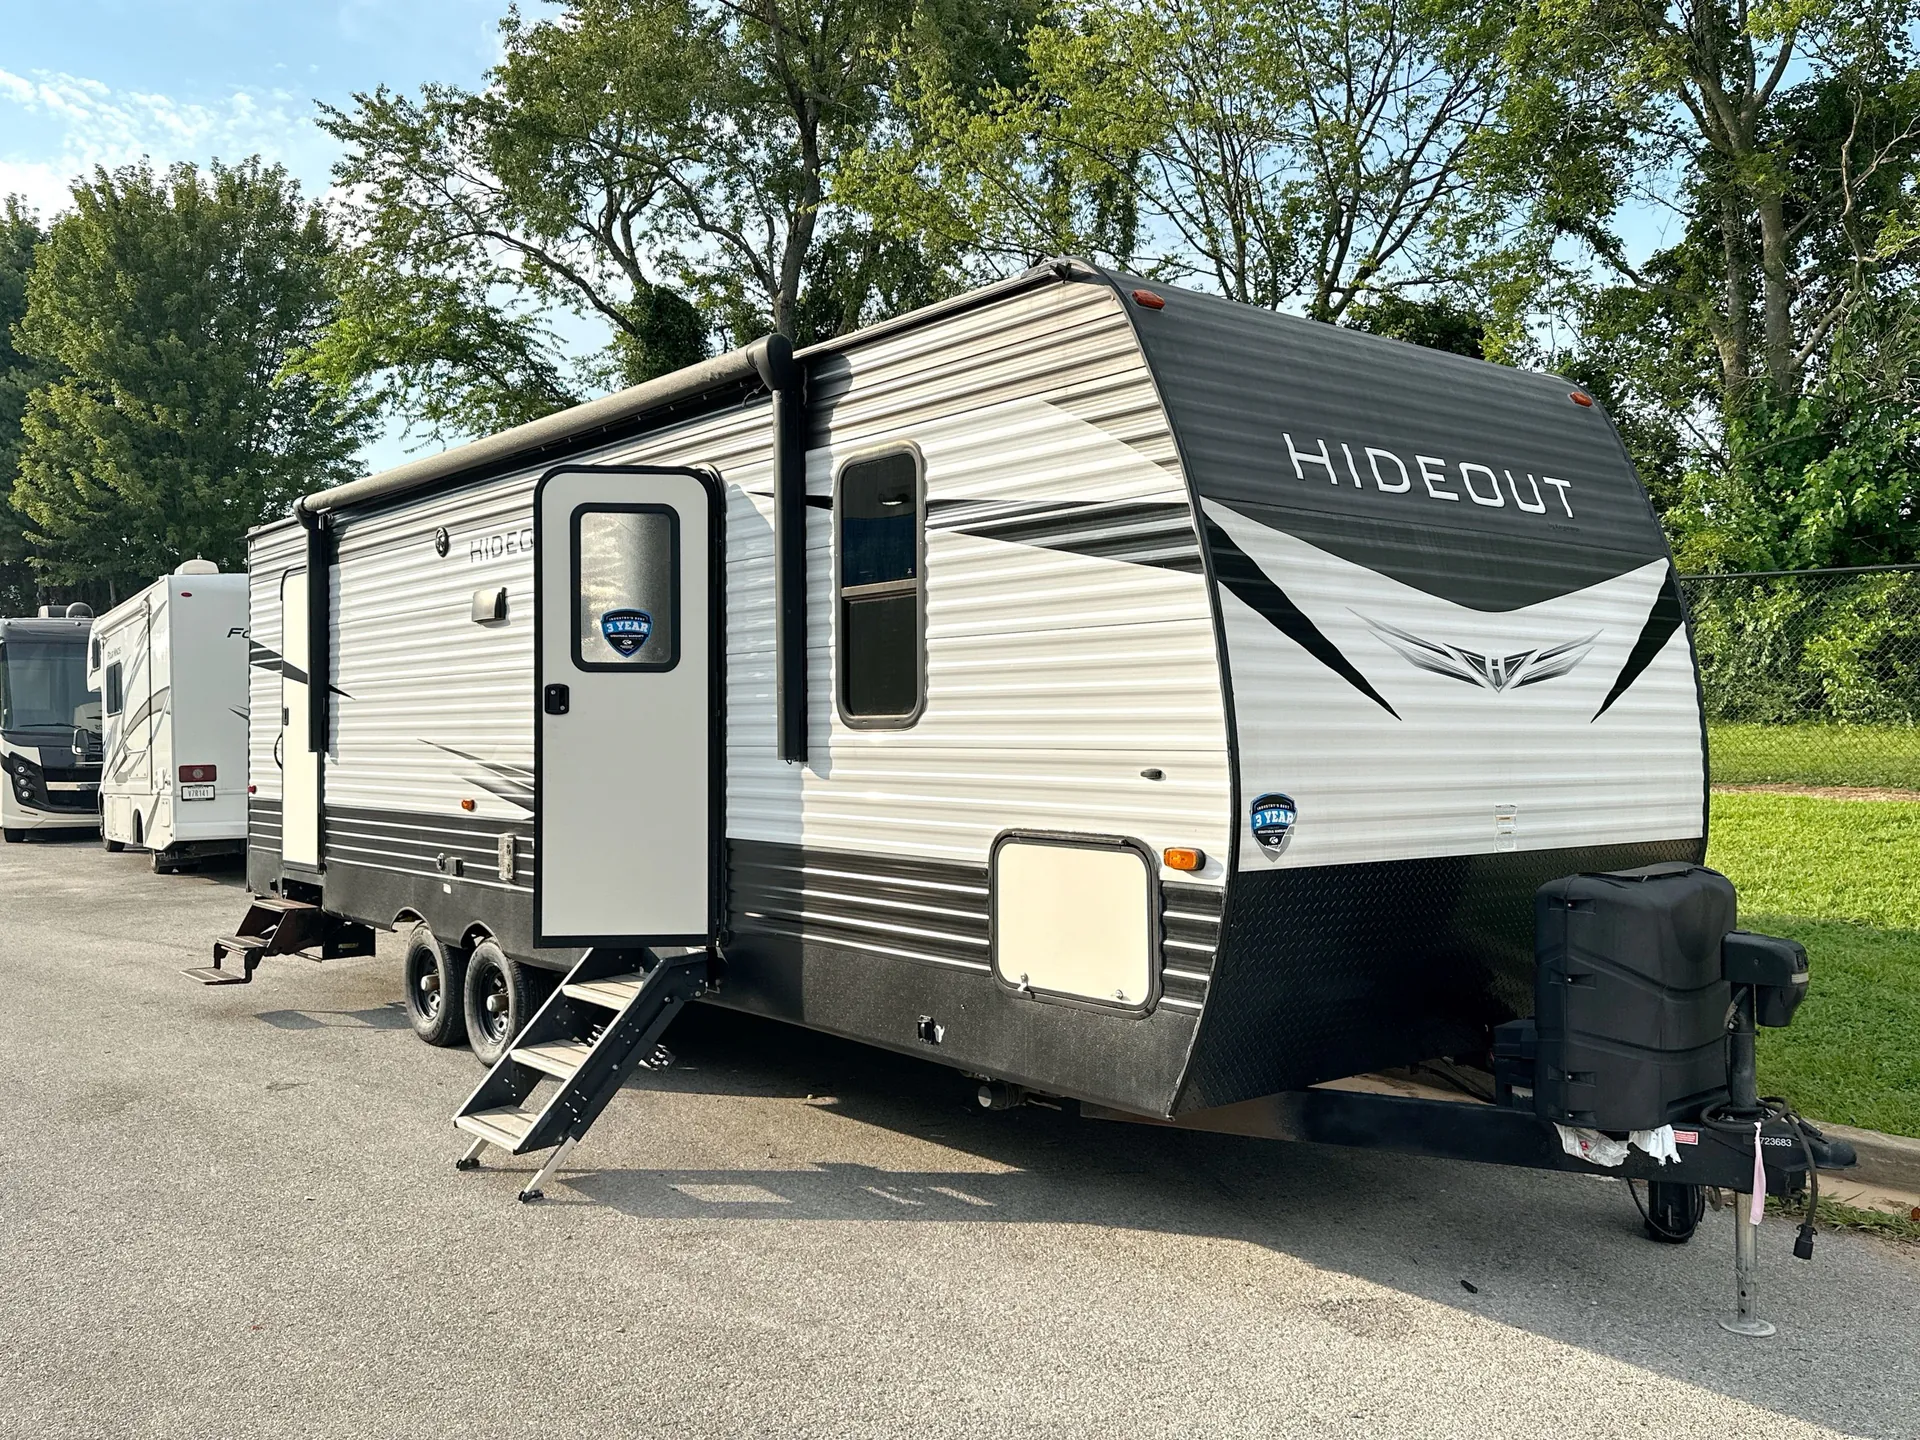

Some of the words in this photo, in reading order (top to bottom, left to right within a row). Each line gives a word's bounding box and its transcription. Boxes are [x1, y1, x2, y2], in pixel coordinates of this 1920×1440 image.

[1281, 432, 1574, 519] HIDEOUT
[470, 528, 533, 563] HIDEO
[606, 623, 614, 632] 3
[616, 621, 648, 632] YEAR
[1255, 814, 1262, 827] 3
[1264, 810, 1294, 824] YEAR
